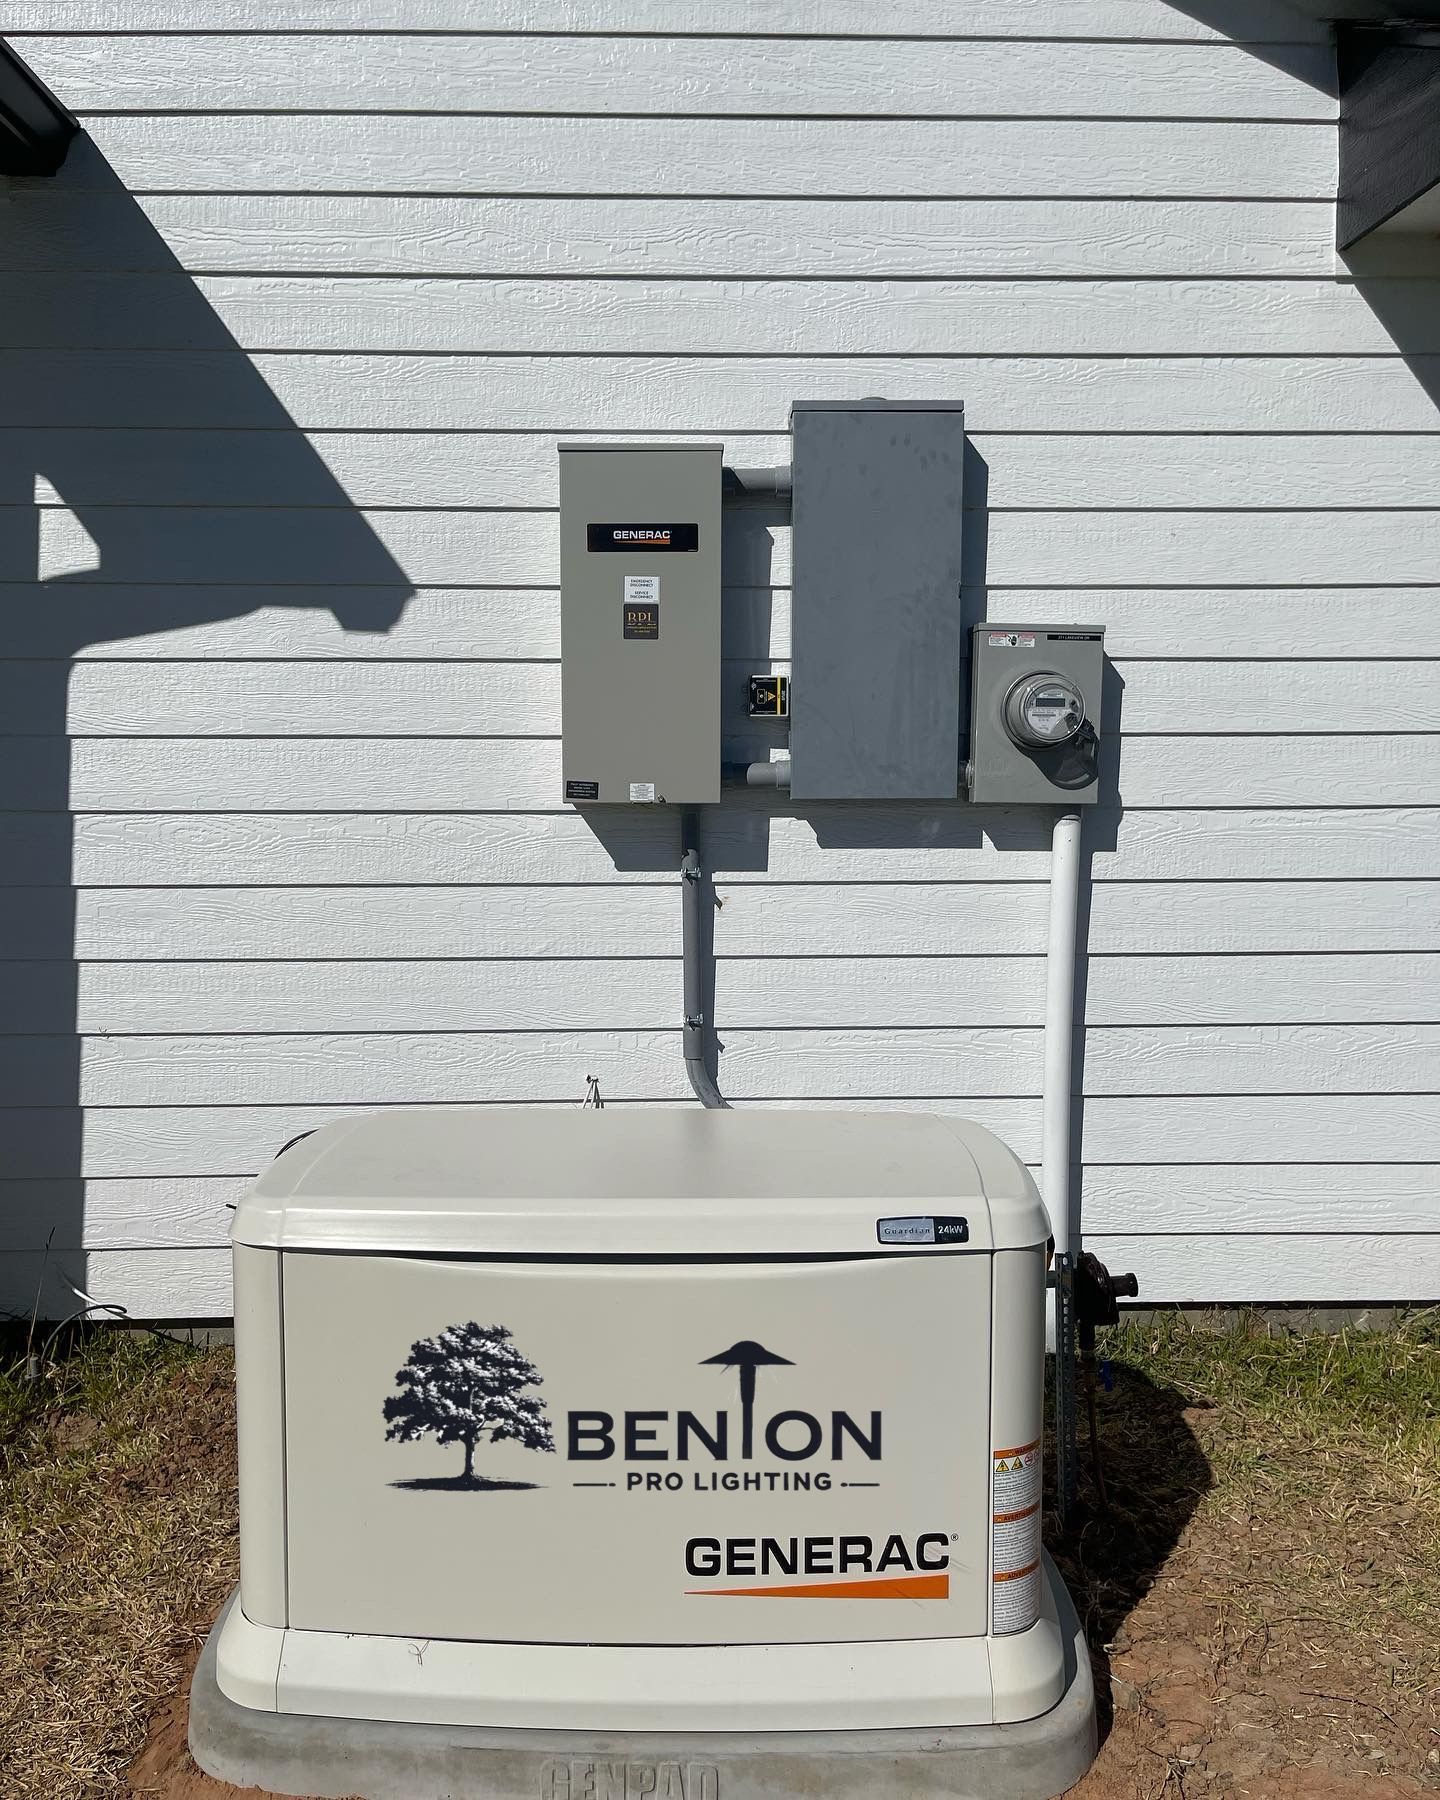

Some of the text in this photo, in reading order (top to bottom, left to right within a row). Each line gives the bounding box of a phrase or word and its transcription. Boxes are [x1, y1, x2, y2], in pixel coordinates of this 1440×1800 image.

[613, 530, 671, 539] GENERAC
[884, 1225, 963, 1235] Guardian 24kW
[567, 1341, 883, 1461] BENTON
[627, 1471, 832, 1491] PRO LIGHTING
